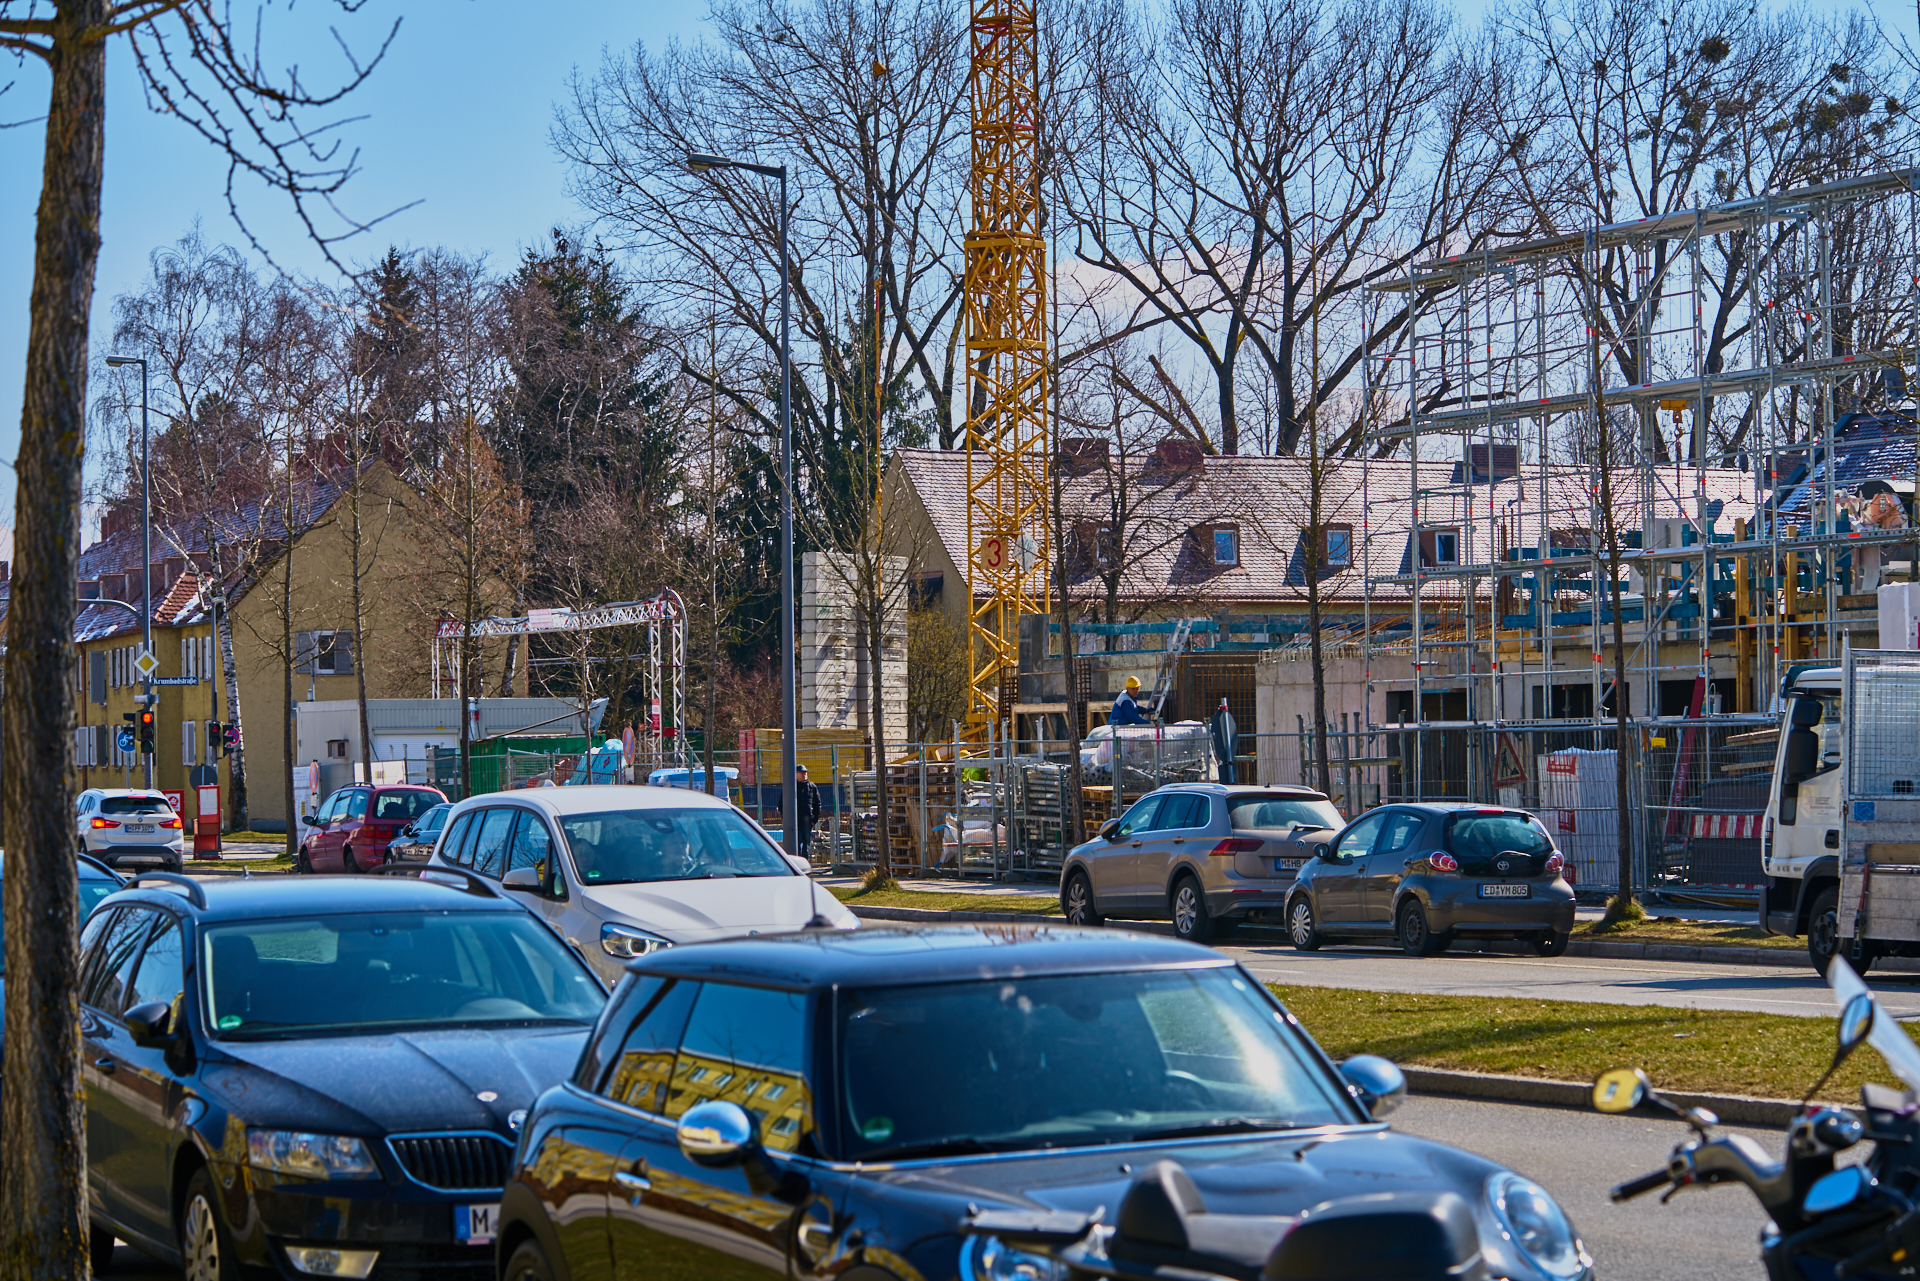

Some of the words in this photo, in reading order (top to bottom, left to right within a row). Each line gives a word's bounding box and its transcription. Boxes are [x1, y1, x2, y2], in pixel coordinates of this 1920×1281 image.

[987, 539, 1001, 567] 3
[1281, 859, 1287, 868] M
[1484, 885, 1496, 895] ED
[1500, 885, 1511, 895] YM
[1511, 885, 1527, 895] 805
[471, 1208, 489, 1234] M
